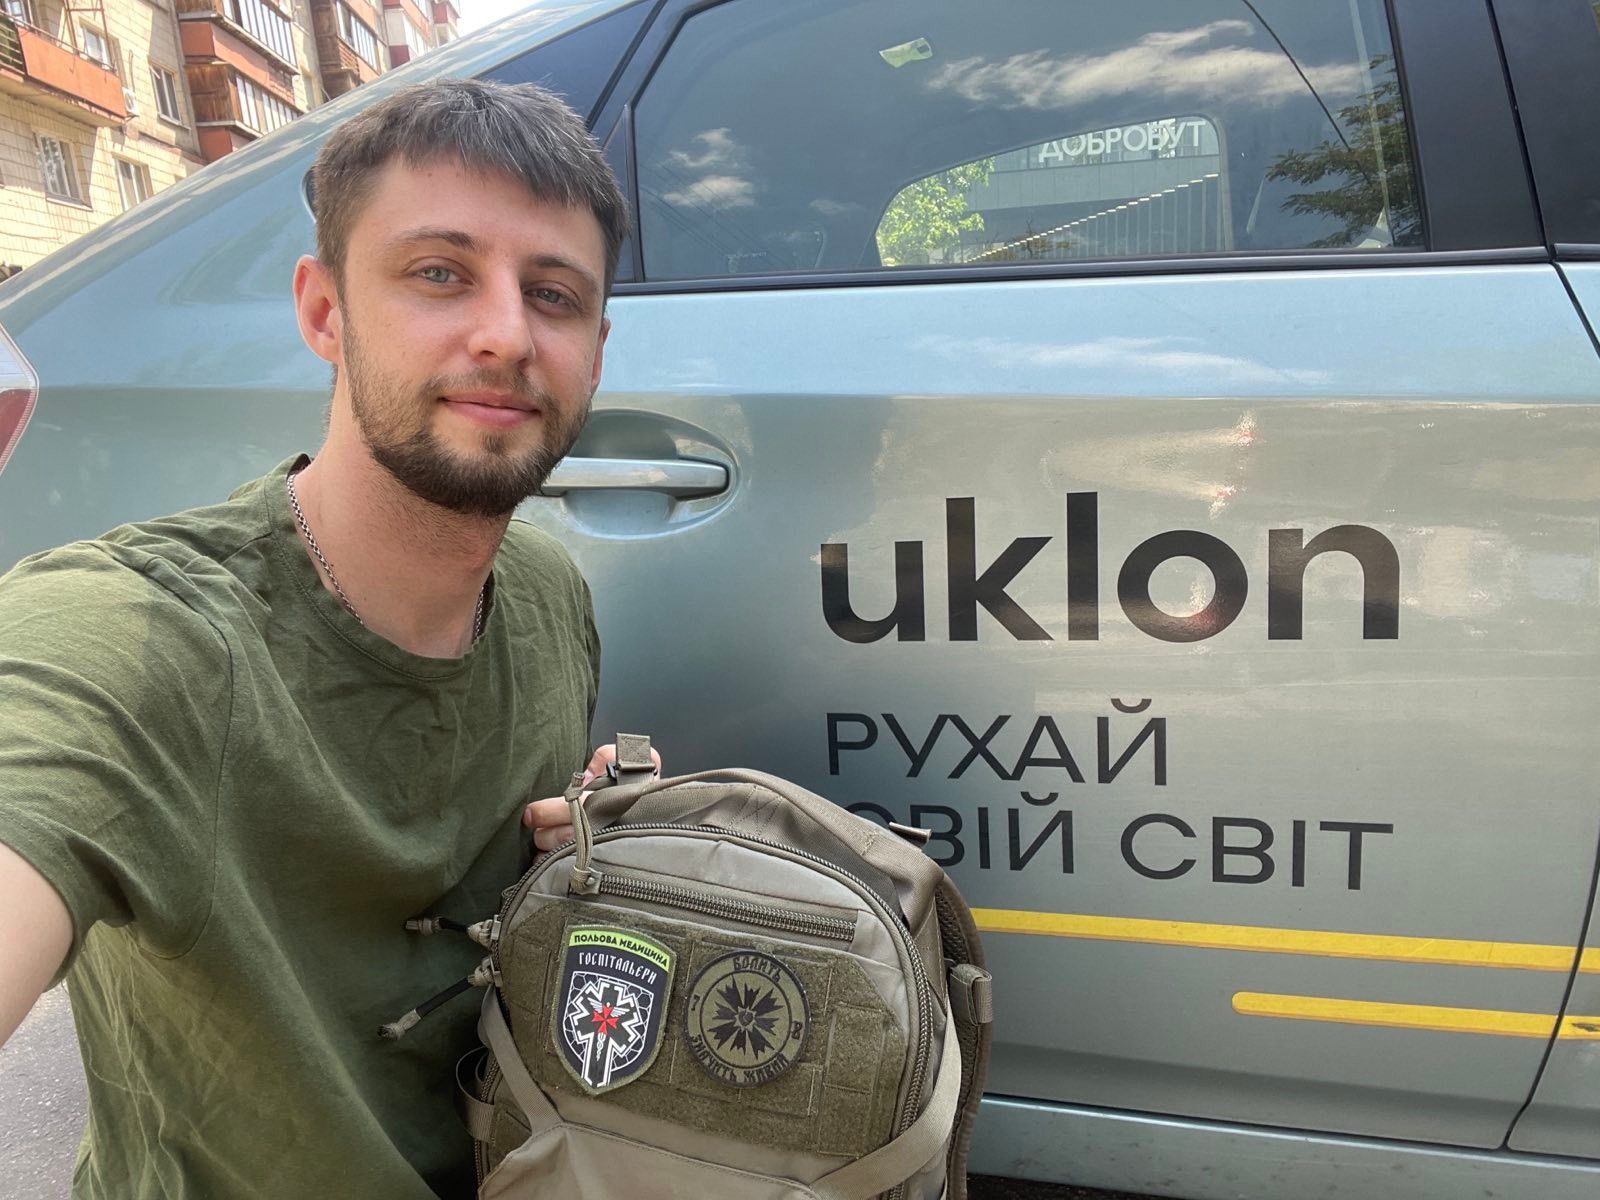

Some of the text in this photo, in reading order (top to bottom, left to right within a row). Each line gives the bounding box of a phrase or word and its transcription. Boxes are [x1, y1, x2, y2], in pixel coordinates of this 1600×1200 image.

[1038, 120, 1206, 163] ДОБРОБУТ
[820, 492, 1400, 644] uklon
[826, 698, 1167, 786] РУХАЙ
[1120, 813, 1394, 890] СВІТ
[574, 934, 667, 967] ПОЛЬОВА МЕДИЦИНА
[733, 956, 781, 983] БОЛИТЬ
